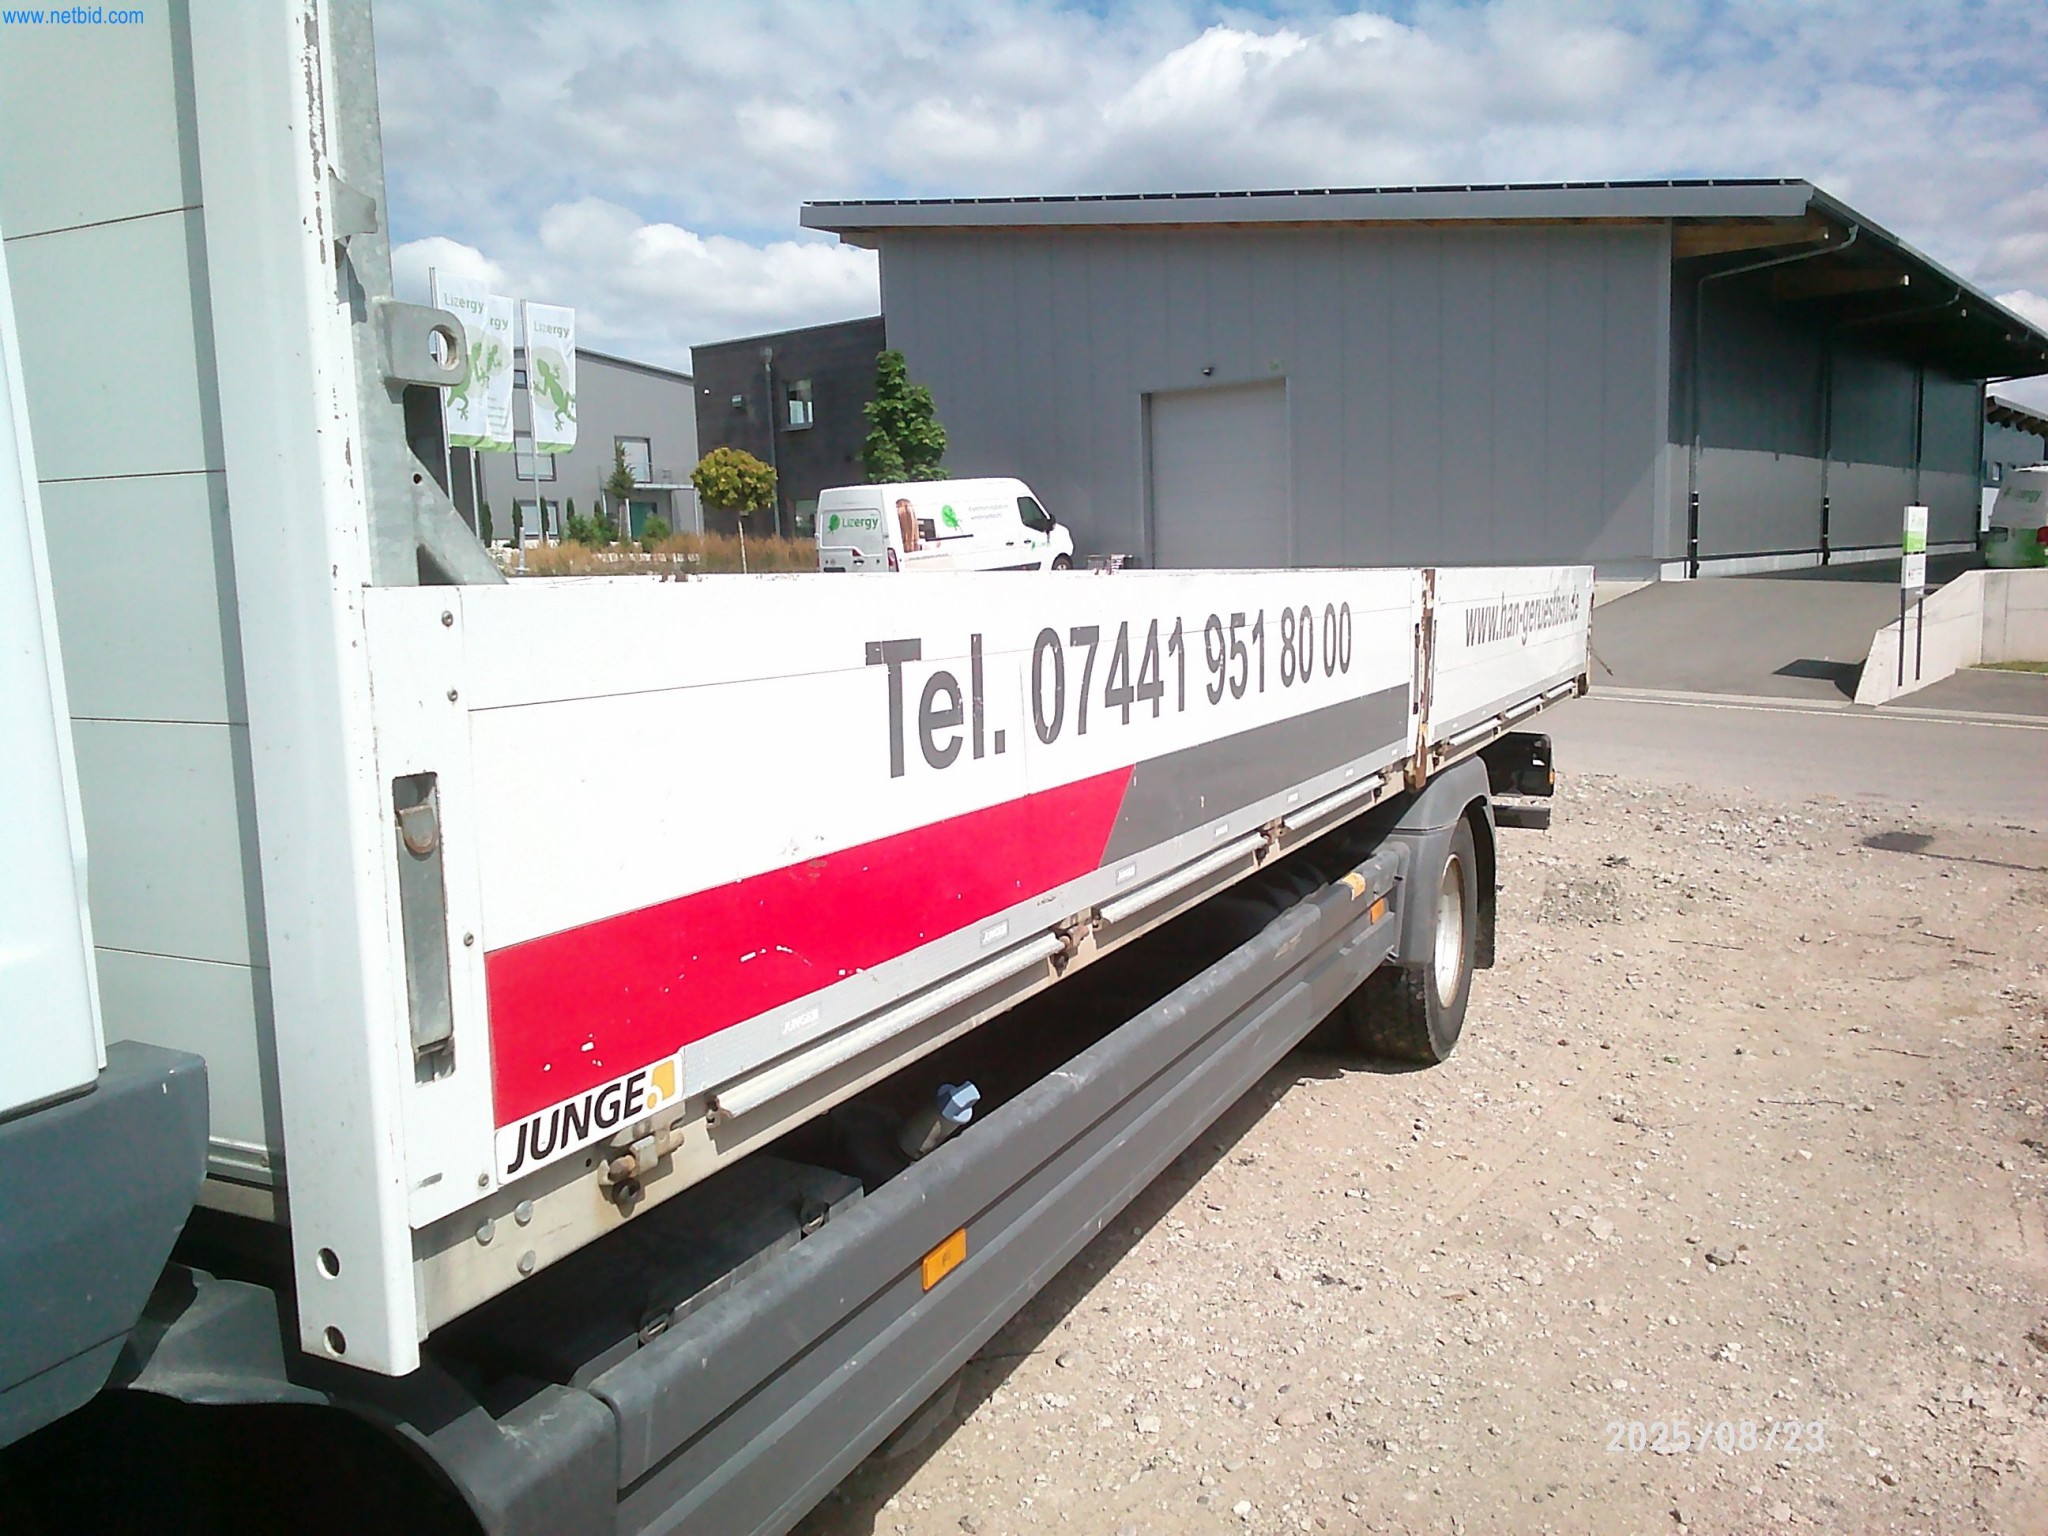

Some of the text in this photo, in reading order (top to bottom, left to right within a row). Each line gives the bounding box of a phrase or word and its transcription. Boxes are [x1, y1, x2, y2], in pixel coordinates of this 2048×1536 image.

[444, 293, 484, 314] Lizergy
[533, 321, 570, 338] Lizergy
[842, 517, 879, 531] Lizergy
[865, 601, 1352, 778] Tel. 07441 951 80 00
[506, 1070, 647, 1174] JUNGE
